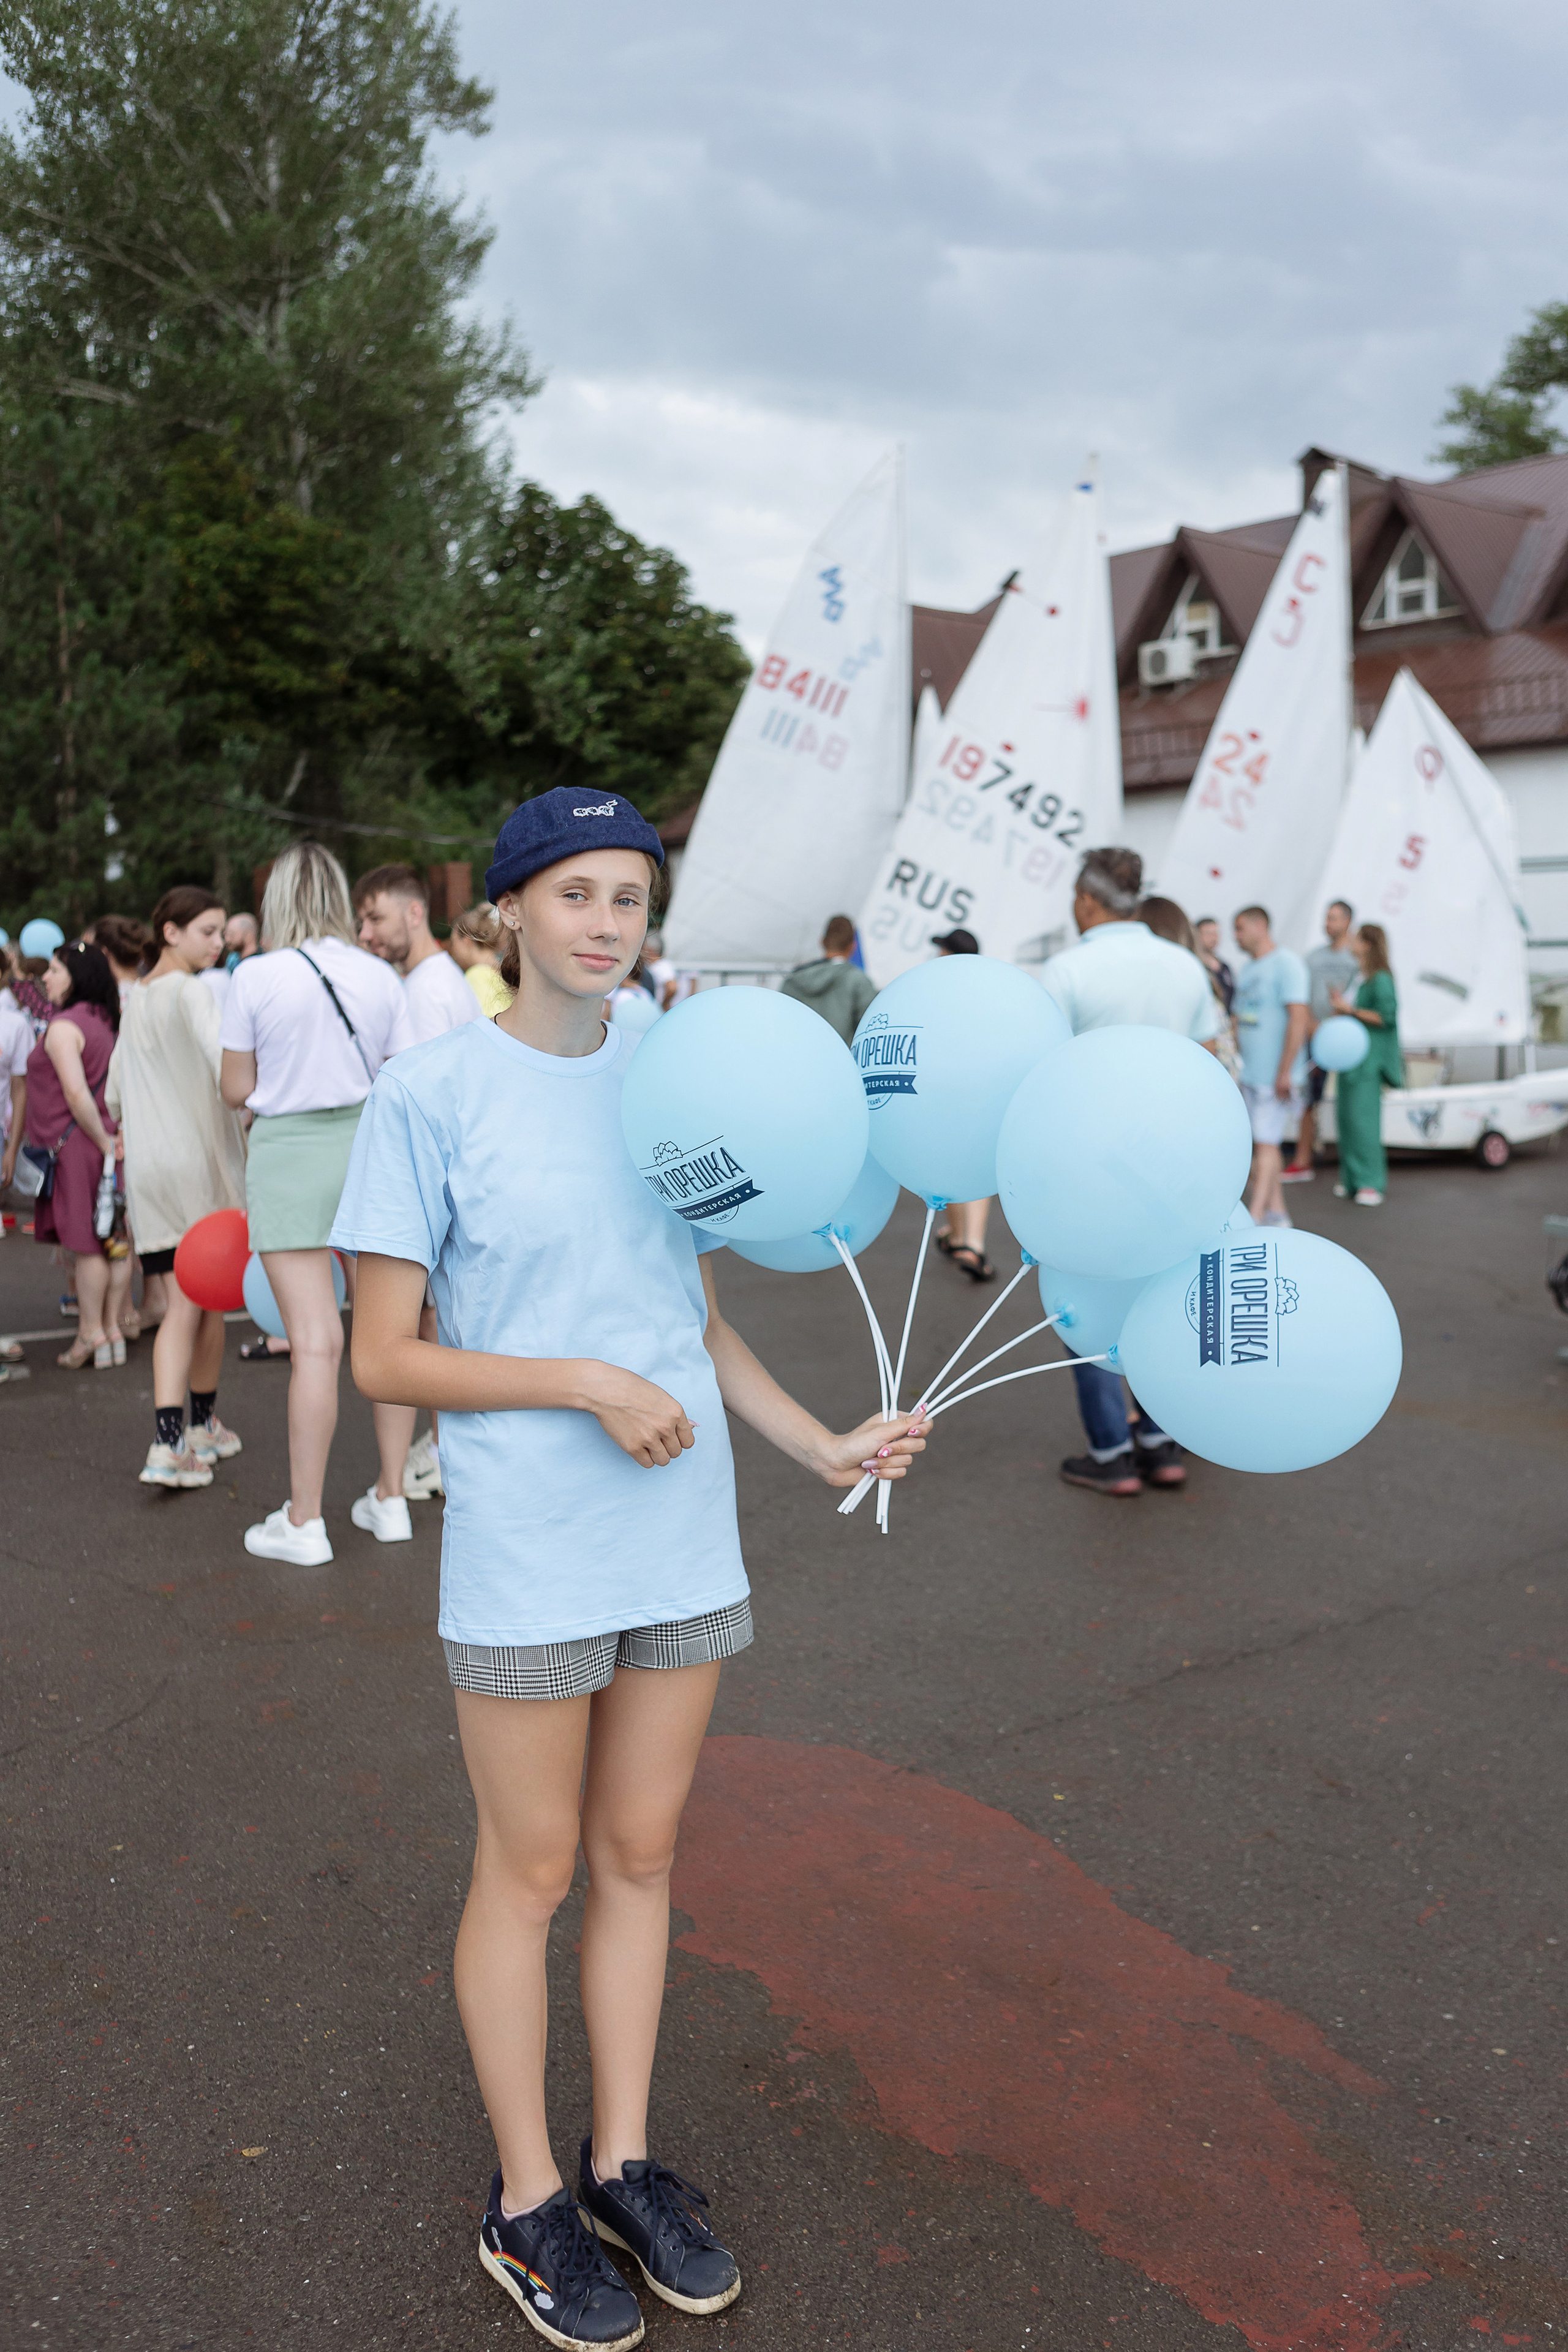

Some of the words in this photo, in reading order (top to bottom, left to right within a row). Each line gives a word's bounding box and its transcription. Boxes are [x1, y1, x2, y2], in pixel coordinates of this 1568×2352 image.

[757, 654, 849, 718] 84111
[1214, 733, 1269, 785] 24
[938, 735, 1087, 848] 197492
[1397, 833, 1427, 871] 5
[888, 858, 975, 924] RUS
[861, 1034, 917, 1068] ОРЕШКА
[644, 1174, 678, 1203] ТРИ
[663, 1147, 746, 1199] ОРЕШКА
[683, 1193, 742, 1218] КОНДИТЕРСКАЯ
[716, 1213, 730, 1223] КАФЕ
[1230, 1243, 1267, 1273] ТРИ
[1231, 1278, 1268, 1366] ОРЕШКА
